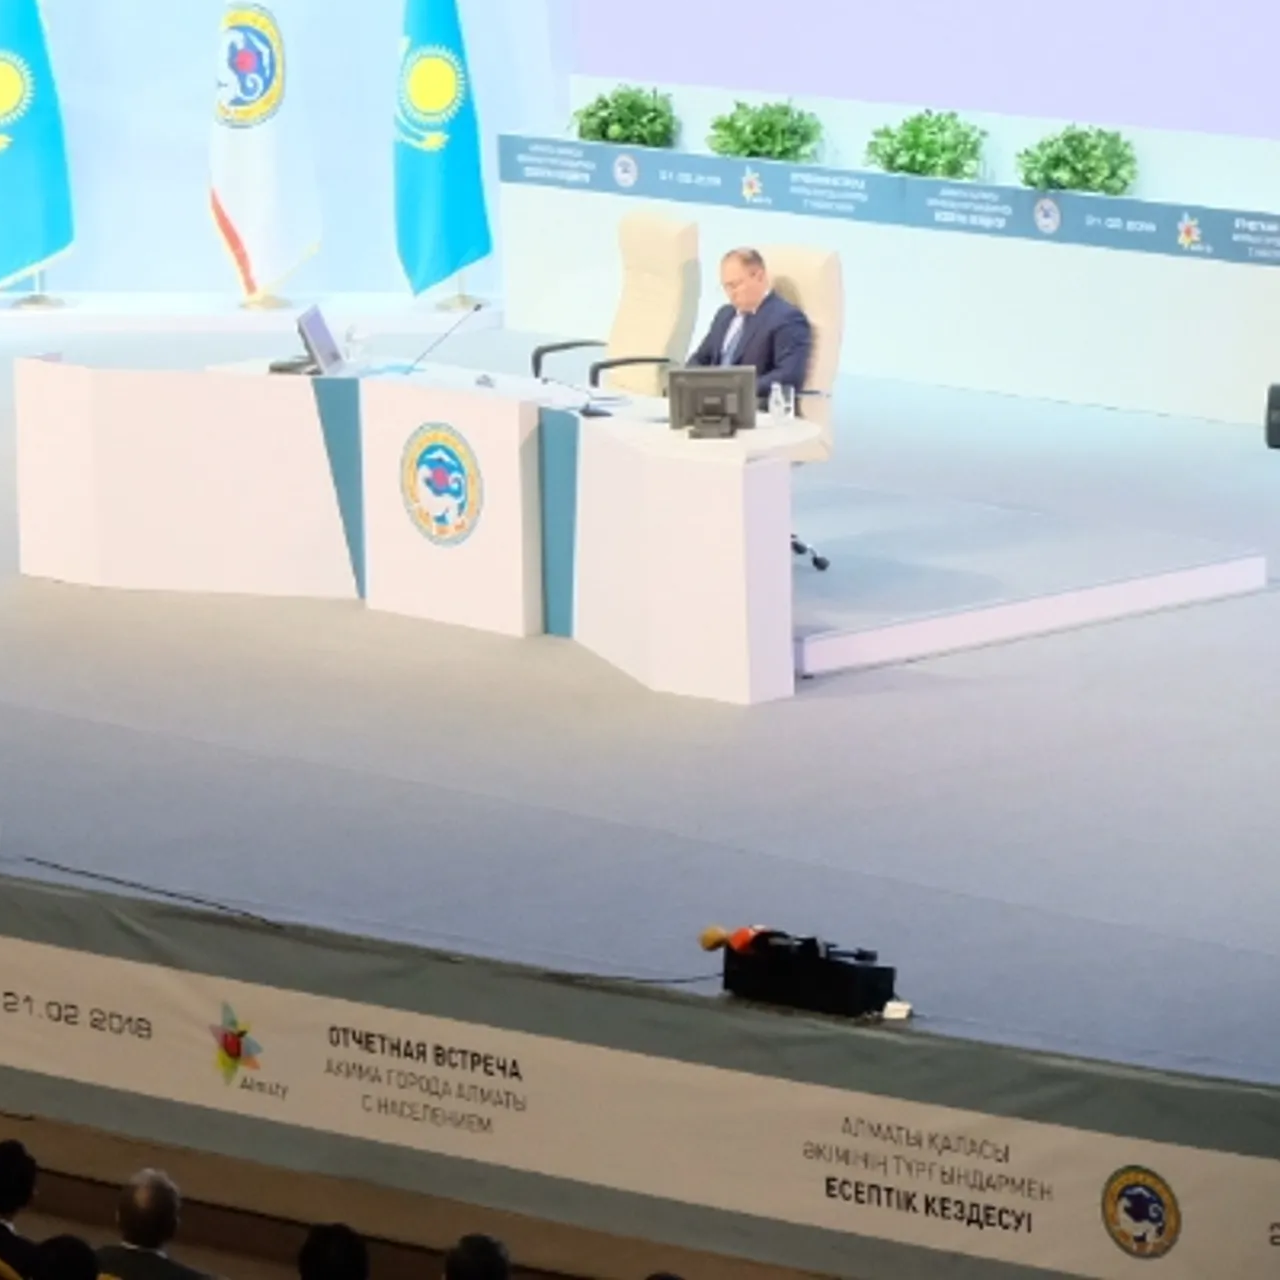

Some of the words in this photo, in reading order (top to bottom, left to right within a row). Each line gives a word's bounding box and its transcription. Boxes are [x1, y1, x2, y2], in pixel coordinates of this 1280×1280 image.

[328, 1025, 428, 1065] ОТЧЕТНАЯ
[432, 1045, 523, 1081] ВСТРЕЧА
[324, 1058, 382, 1084] АКИМА
[386, 1068, 452, 1099] ГОРОДА
[455, 1083, 528, 1112] АЛМАТЫ
[361, 1093, 373, 1113] С
[376, 1096, 494, 1135] НАСЕЛЕНИЕМ
[841, 1116, 923, 1149] АЛМАТЫ
[926, 1132, 1010, 1164] ҚАЛАСЫ
[825, 1176, 919, 1214] ЕСЕПТІК
[923, 1193, 1033, 1233] КЕЗДЕСУІ
